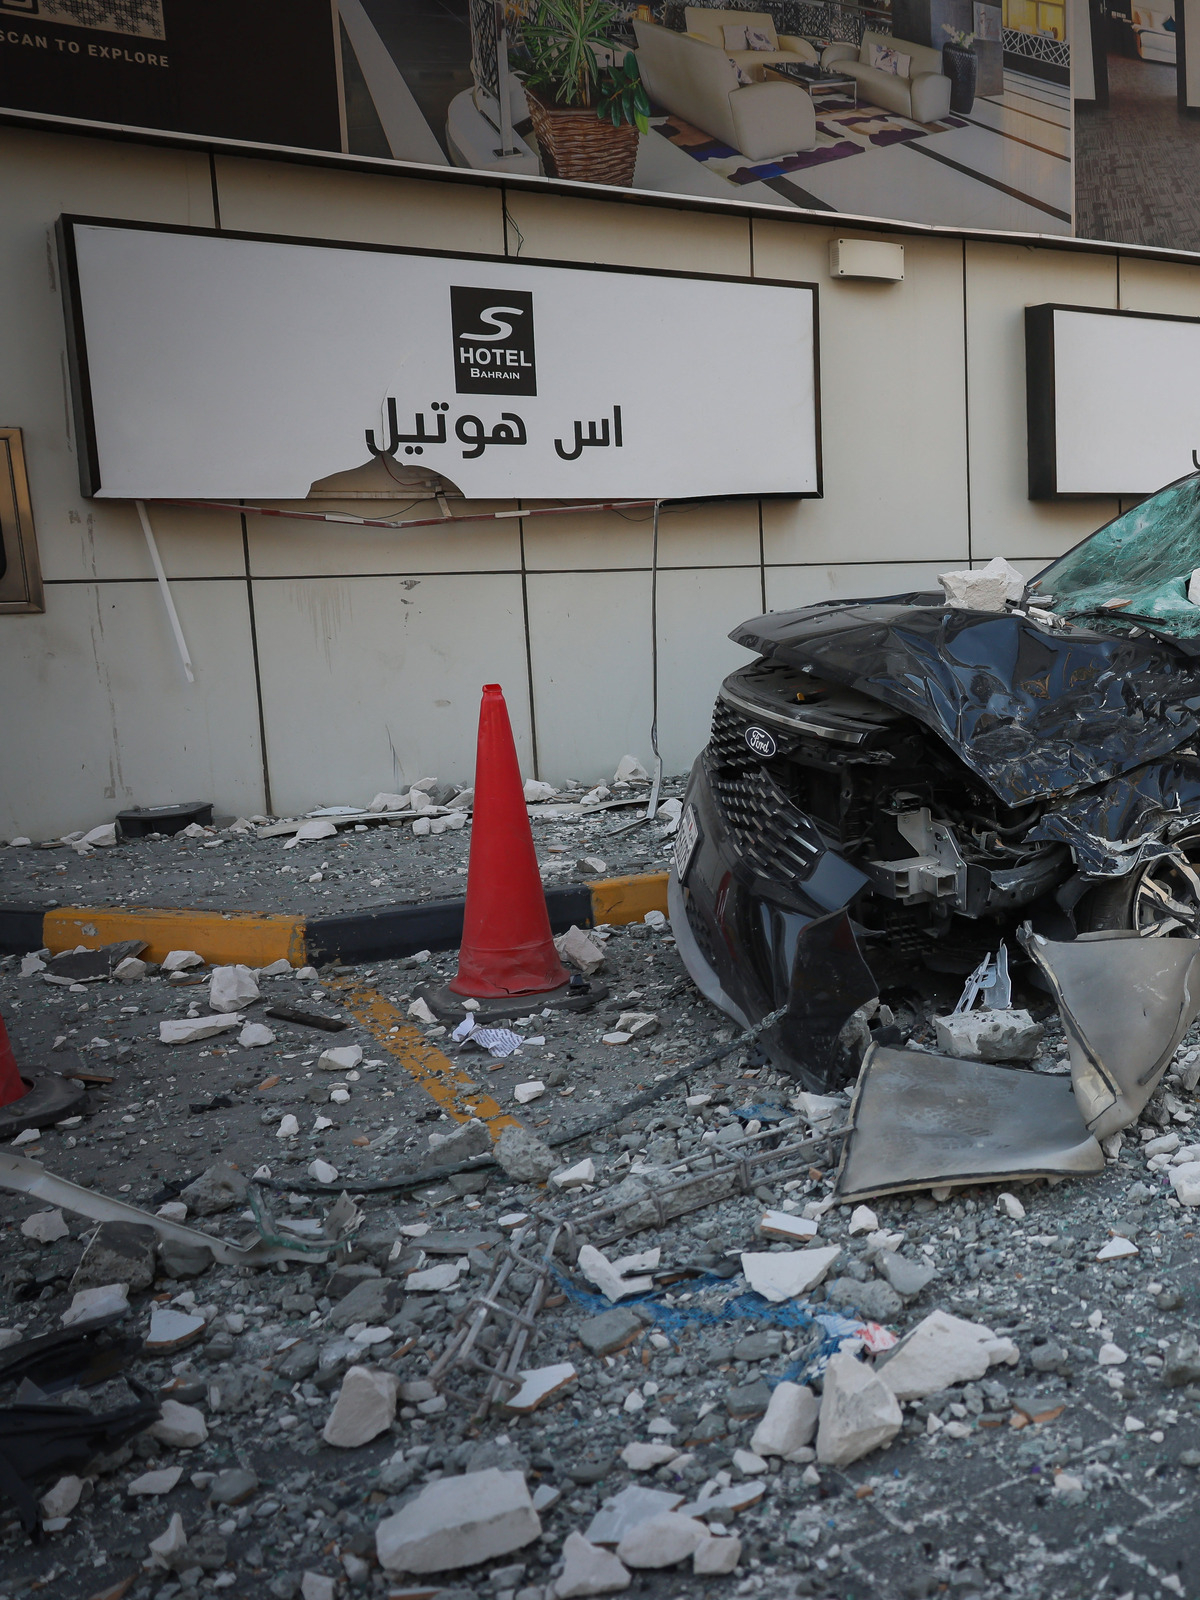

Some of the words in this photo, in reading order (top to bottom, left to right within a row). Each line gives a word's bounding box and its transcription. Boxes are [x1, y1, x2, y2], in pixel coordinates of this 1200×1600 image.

[54, 38, 80, 54] TO
[87, 44, 170, 68] EXPLORE
[459, 306, 524, 342] S
[459, 347, 532, 367] HOTEL
[365, 397, 528, 460] هوتيل
[553, 405, 623, 461] اس
[750, 730, 770, 753] Ford
